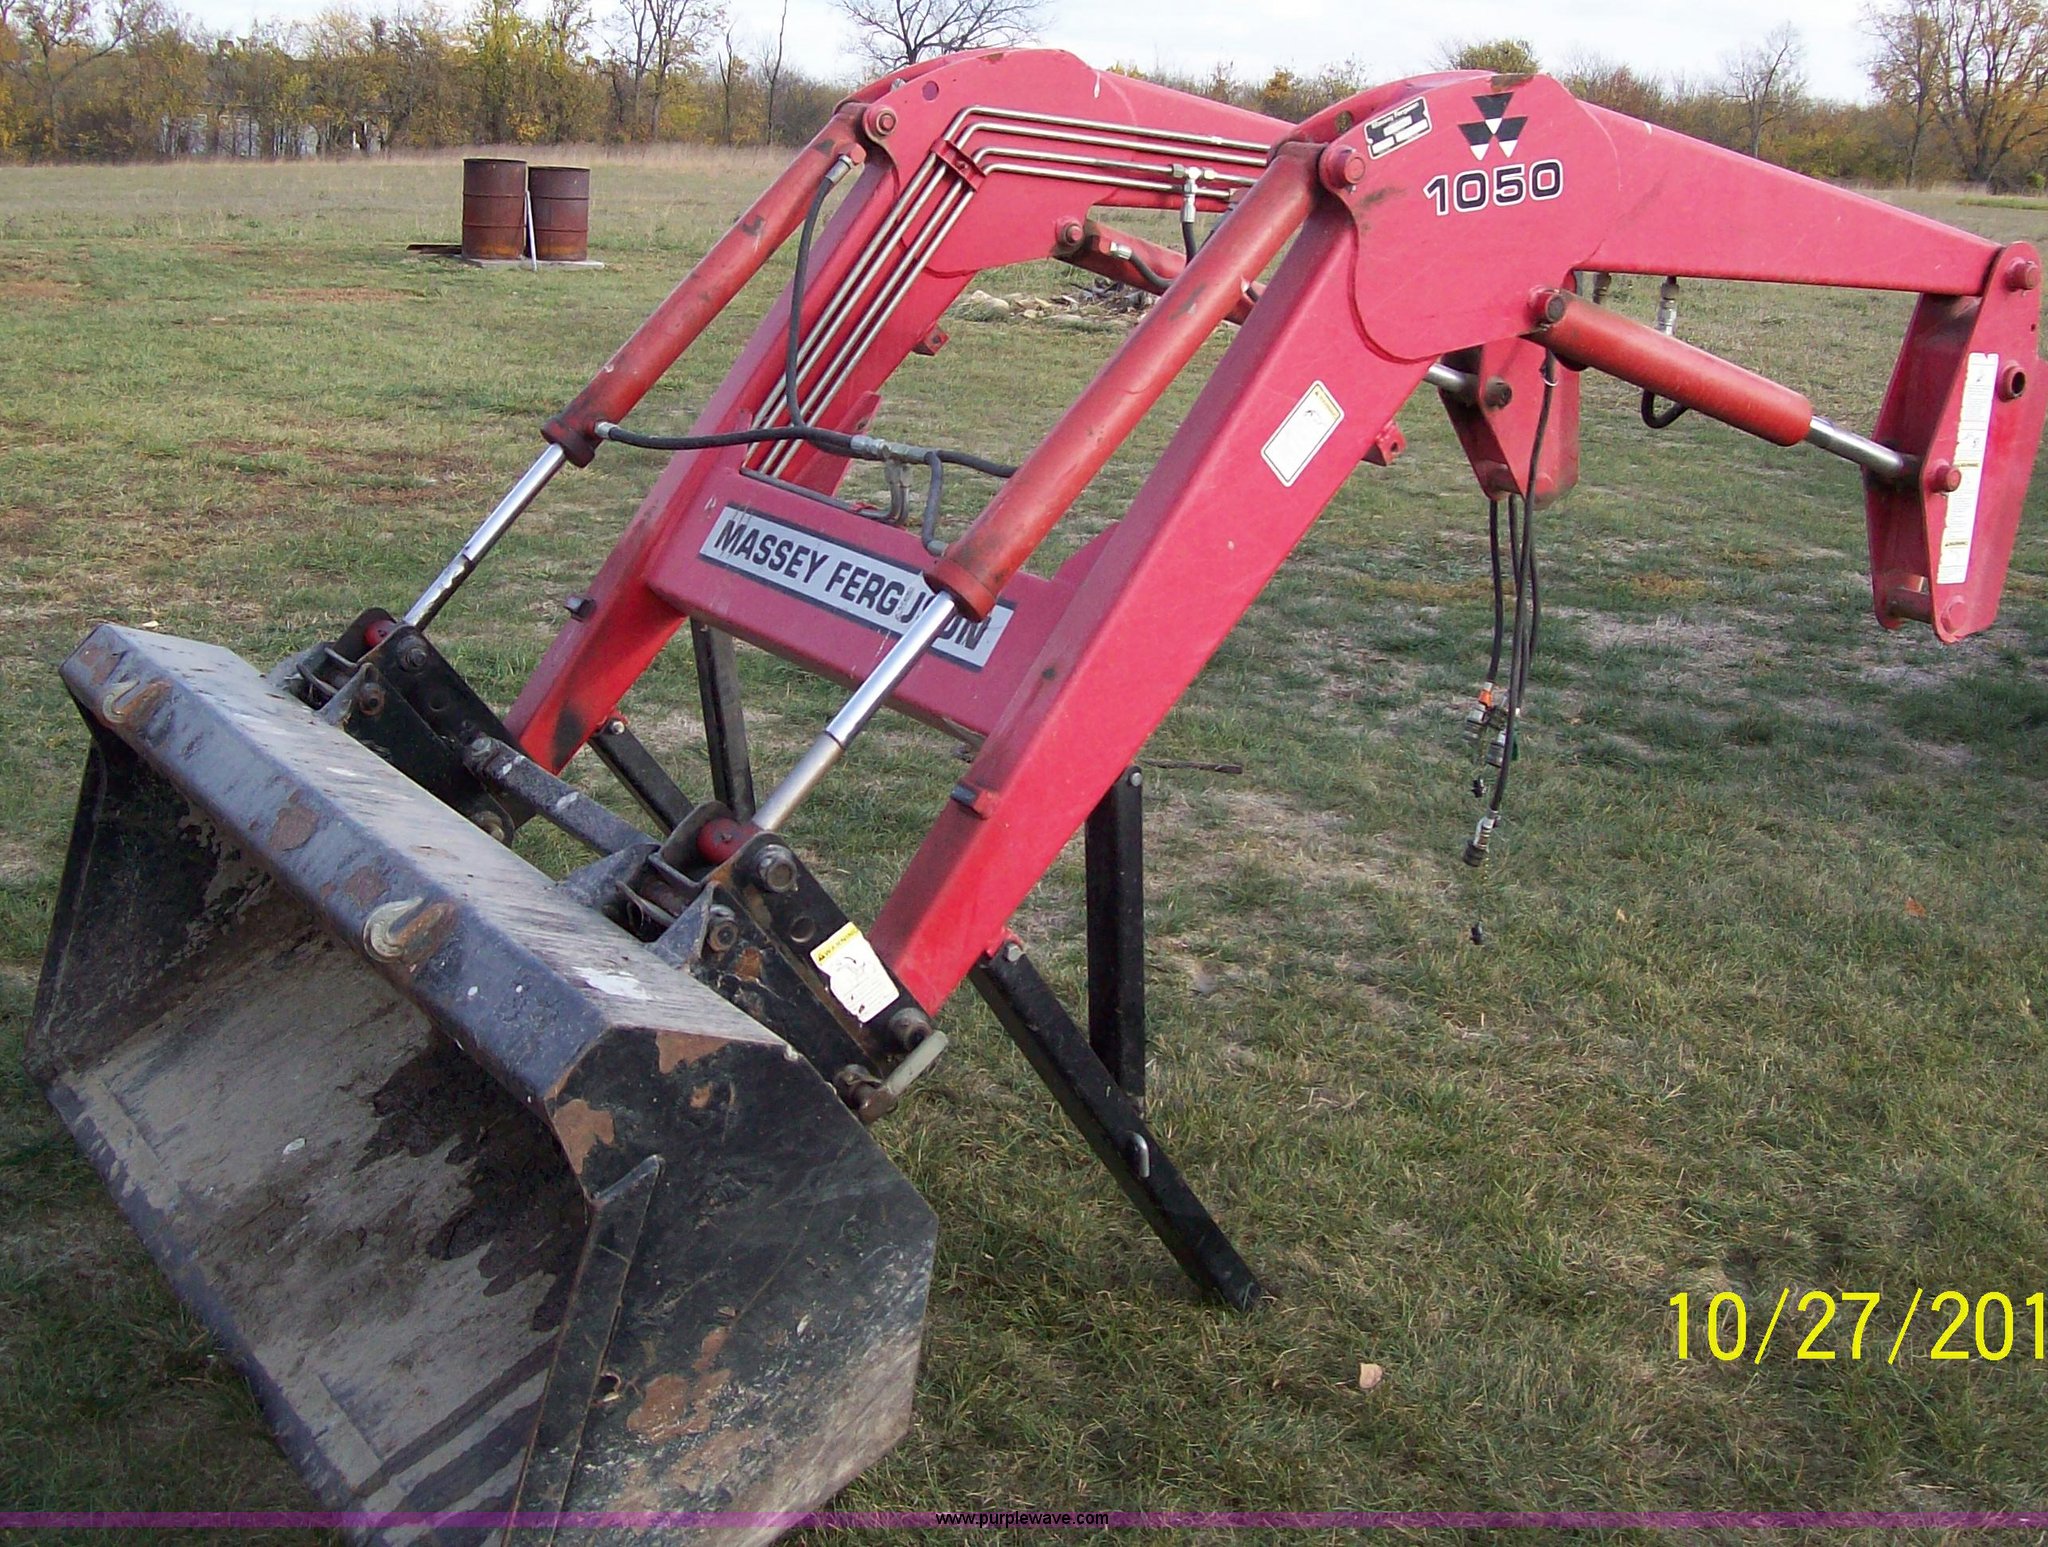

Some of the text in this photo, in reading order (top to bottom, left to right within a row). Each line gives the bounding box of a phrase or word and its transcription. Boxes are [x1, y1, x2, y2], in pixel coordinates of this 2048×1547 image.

[1423, 159, 1563, 216] 1050
[714, 520, 992, 650] MASSEY FERGUN
